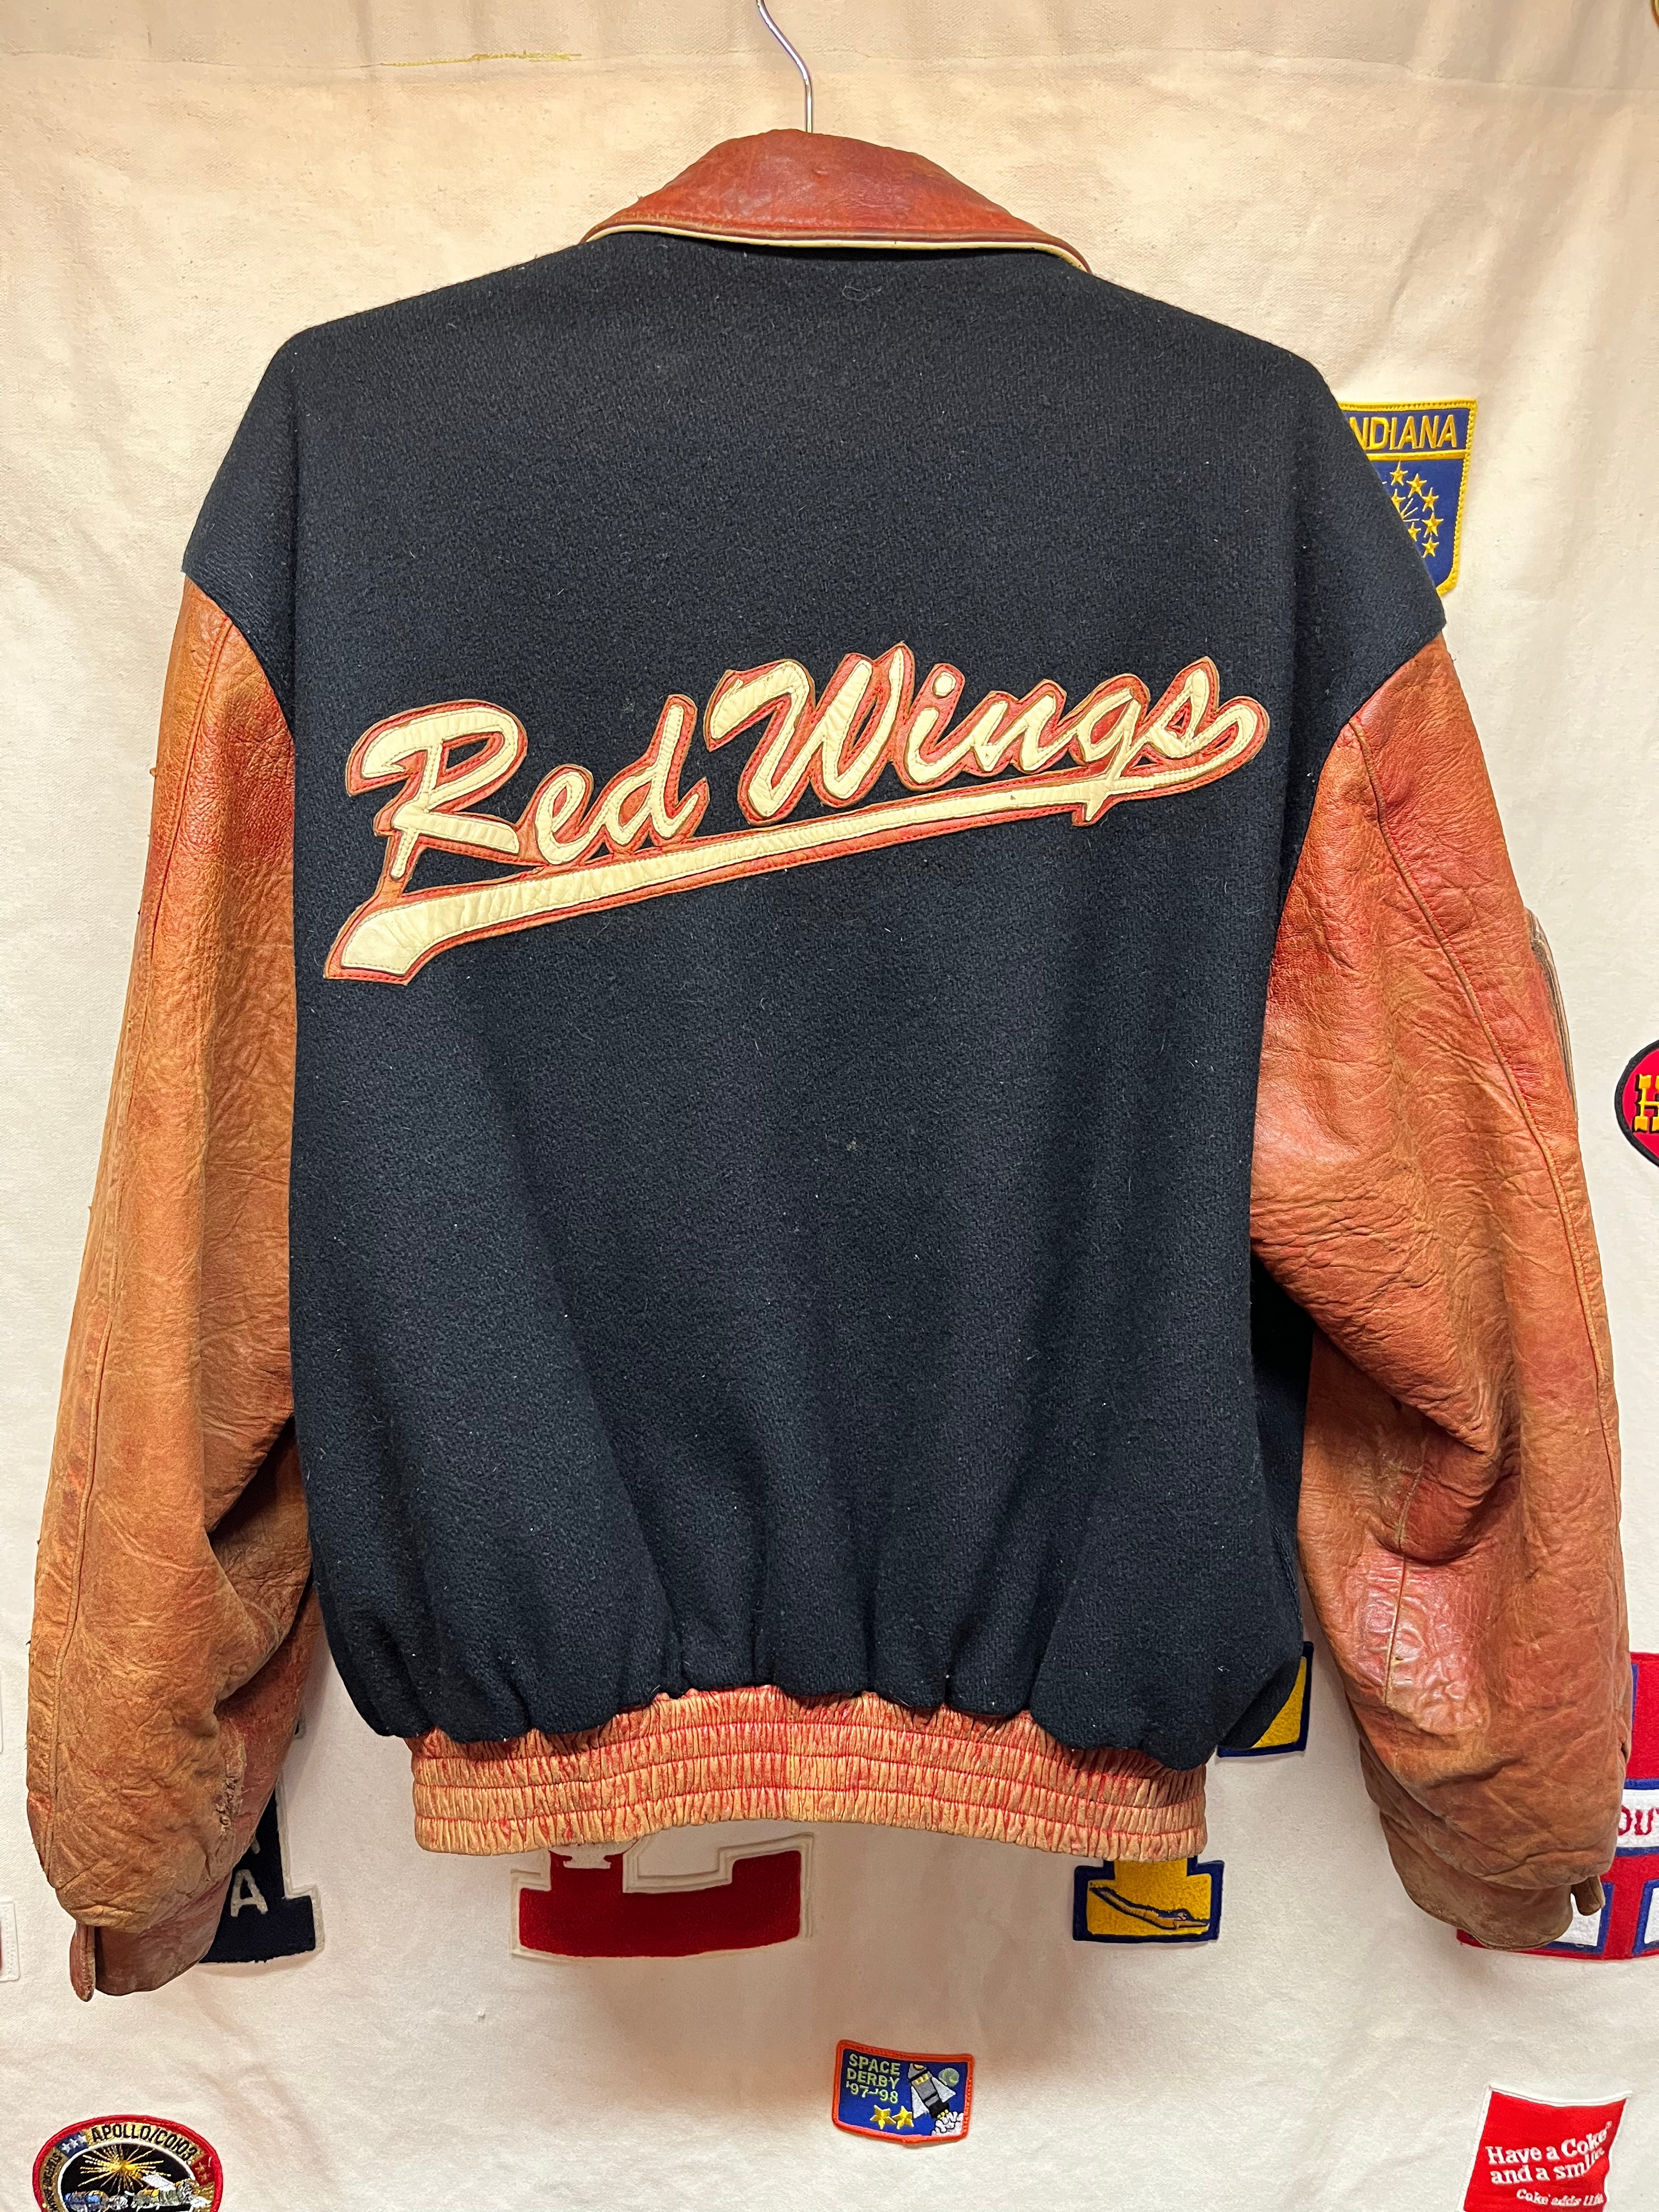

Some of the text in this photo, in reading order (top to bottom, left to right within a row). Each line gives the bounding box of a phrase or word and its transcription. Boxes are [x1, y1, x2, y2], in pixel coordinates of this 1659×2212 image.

[1350, 414, 1458, 450] NDIANA
[346, 641, 1269, 883] Red Wings
[849, 2053, 901, 2076] SPACE
[847, 2068, 900, 2090] DERBY
[1485, 2146, 1542, 2164] Have
[1546, 2146, 1560, 2160] a
[1490, 2165, 1533, 2185] and
[1536, 2167, 1550, 2181] a
[1551, 2195, 1582, 2207] adds
